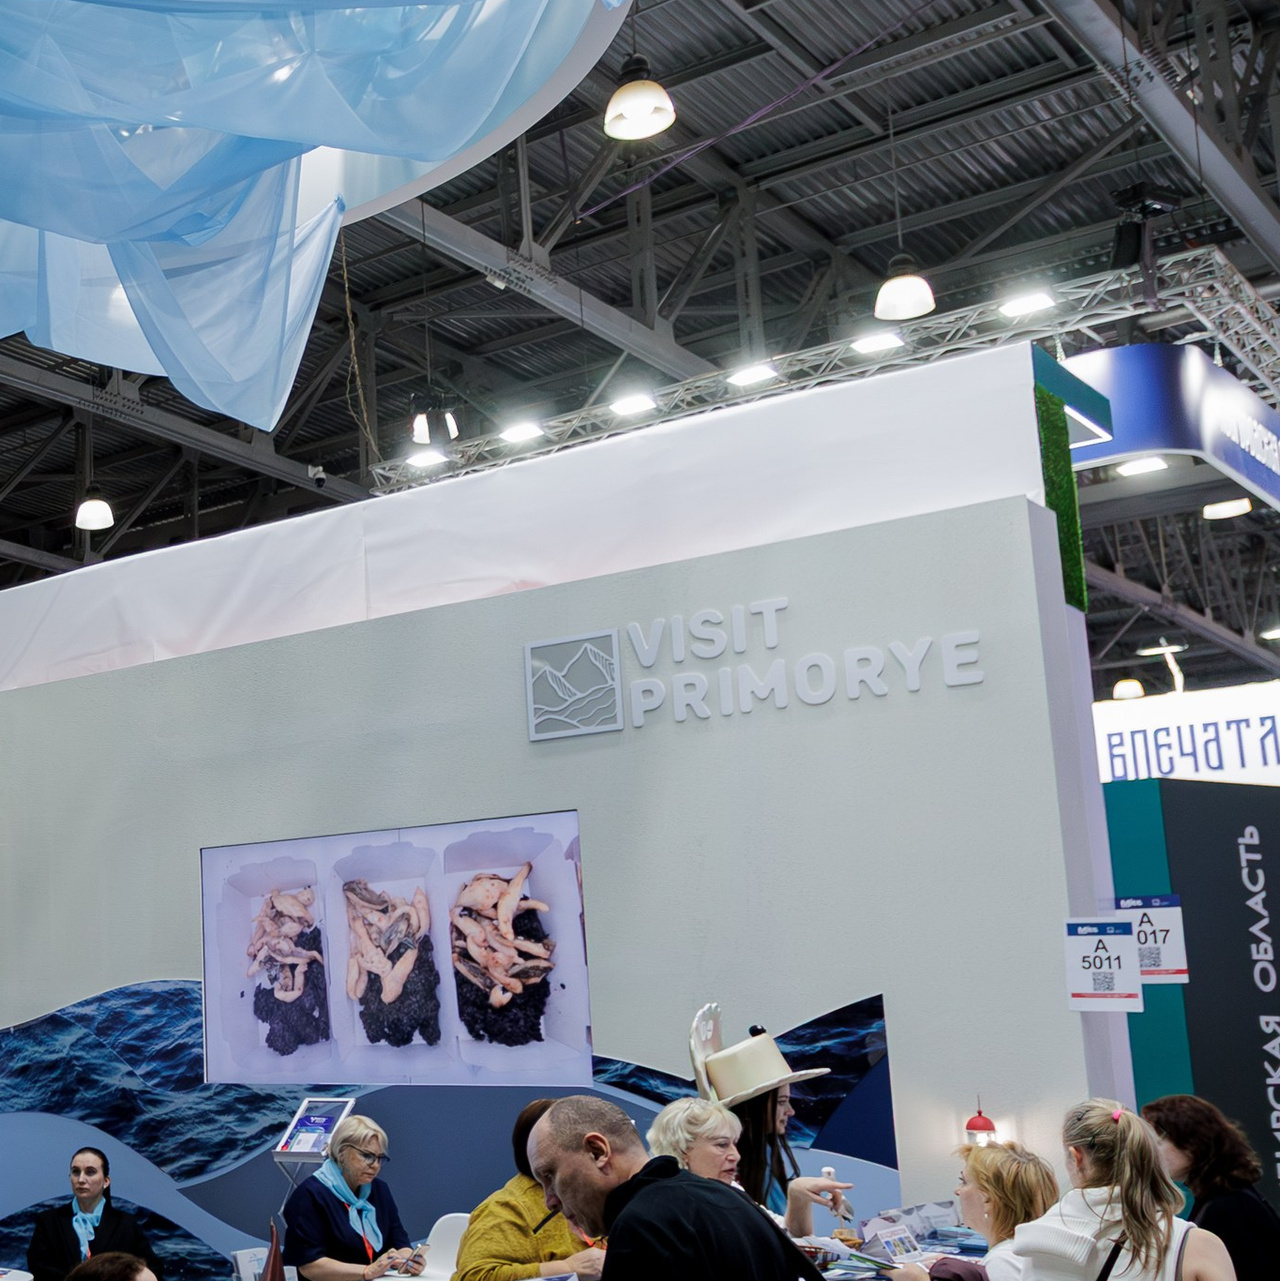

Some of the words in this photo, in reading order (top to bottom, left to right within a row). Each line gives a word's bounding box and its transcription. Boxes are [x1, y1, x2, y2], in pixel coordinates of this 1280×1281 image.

[627, 597, 788, 668] VISIT
[629, 629, 985, 728] PRIMORYE
[1136, 929, 1170, 945] 017
[1238, 826, 1277, 993] ОБЛАСТЬ
[1081, 955, 1122, 970] 5011
